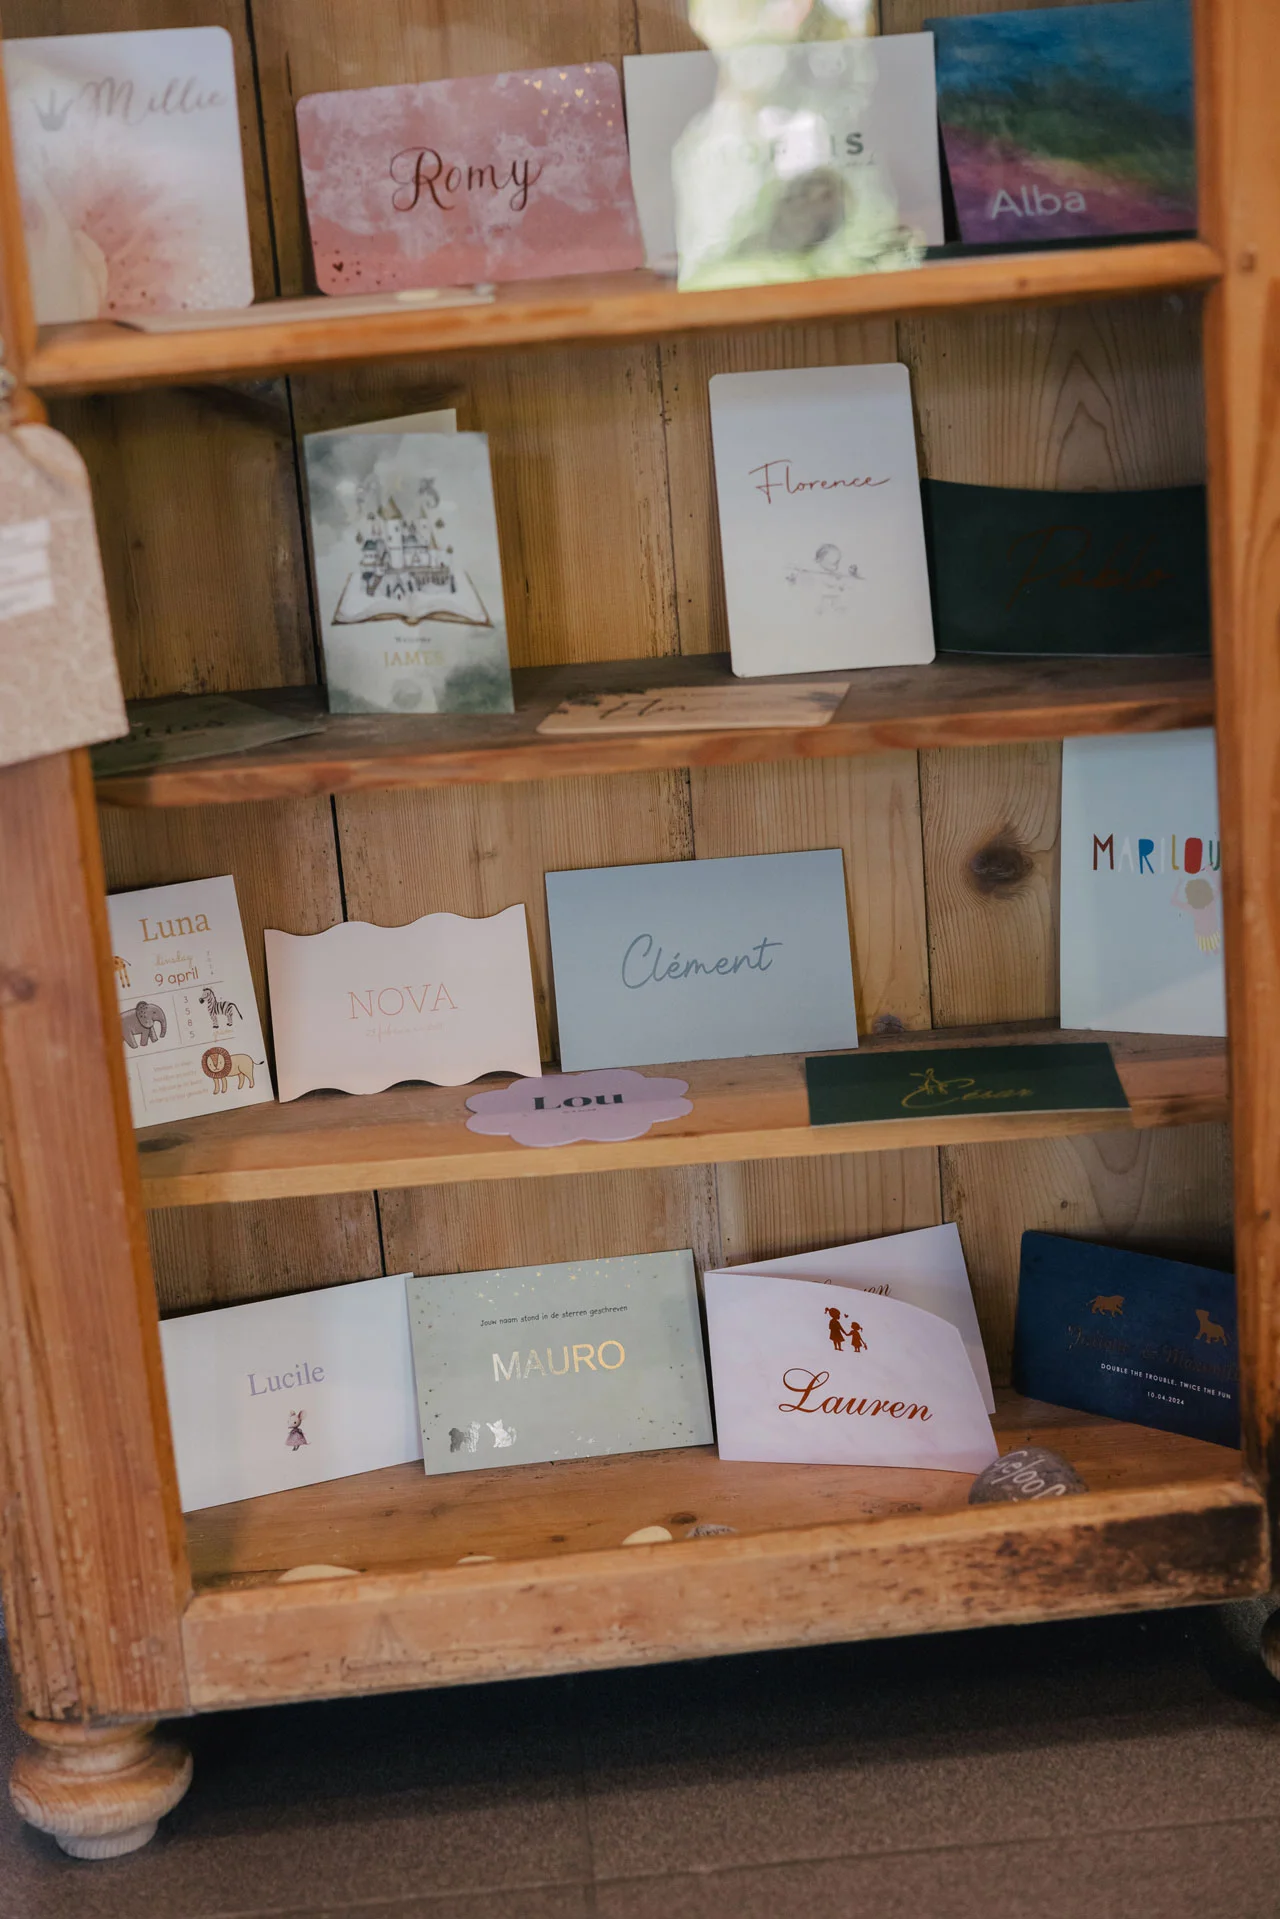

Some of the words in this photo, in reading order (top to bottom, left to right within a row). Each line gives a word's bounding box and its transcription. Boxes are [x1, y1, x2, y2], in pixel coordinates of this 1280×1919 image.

[390, 146, 543, 212] Romy
[991, 184, 1087, 220] Alba
[748, 459, 890, 504] Florence
[1093, 833, 1220, 875] MARILOU
[138, 913, 212, 942] Luna
[154, 973, 164, 987] 9
[167, 966, 199, 986] april
[621, 933, 783, 989] Clément
[347, 982, 458, 1019] NOVA
[532, 1093, 624, 1110] Lou
[480, 1319, 497, 1327] Jouw
[499, 1317, 518, 1325] naam
[520, 1314, 540, 1323] stond
[550, 1311, 559, 1319] de
[562, 1309, 588, 1318] sterren
[589, 1305, 628, 1317] geschreven
[247, 1362, 326, 1396] Lucile
[492, 1340, 626, 1382] MAURO
[778, 1367, 933, 1422] Lauren
[1100, 1363, 1128, 1374] DOUBLE
[1130, 1369, 1143, 1378] THE
[1180, 1381, 1201, 1392] TWICE
[1203, 1387, 1215, 1396] THE
[1218, 1391, 1231, 1399] FUN
[1147, 1391, 1185, 1405] 10.04.2024
